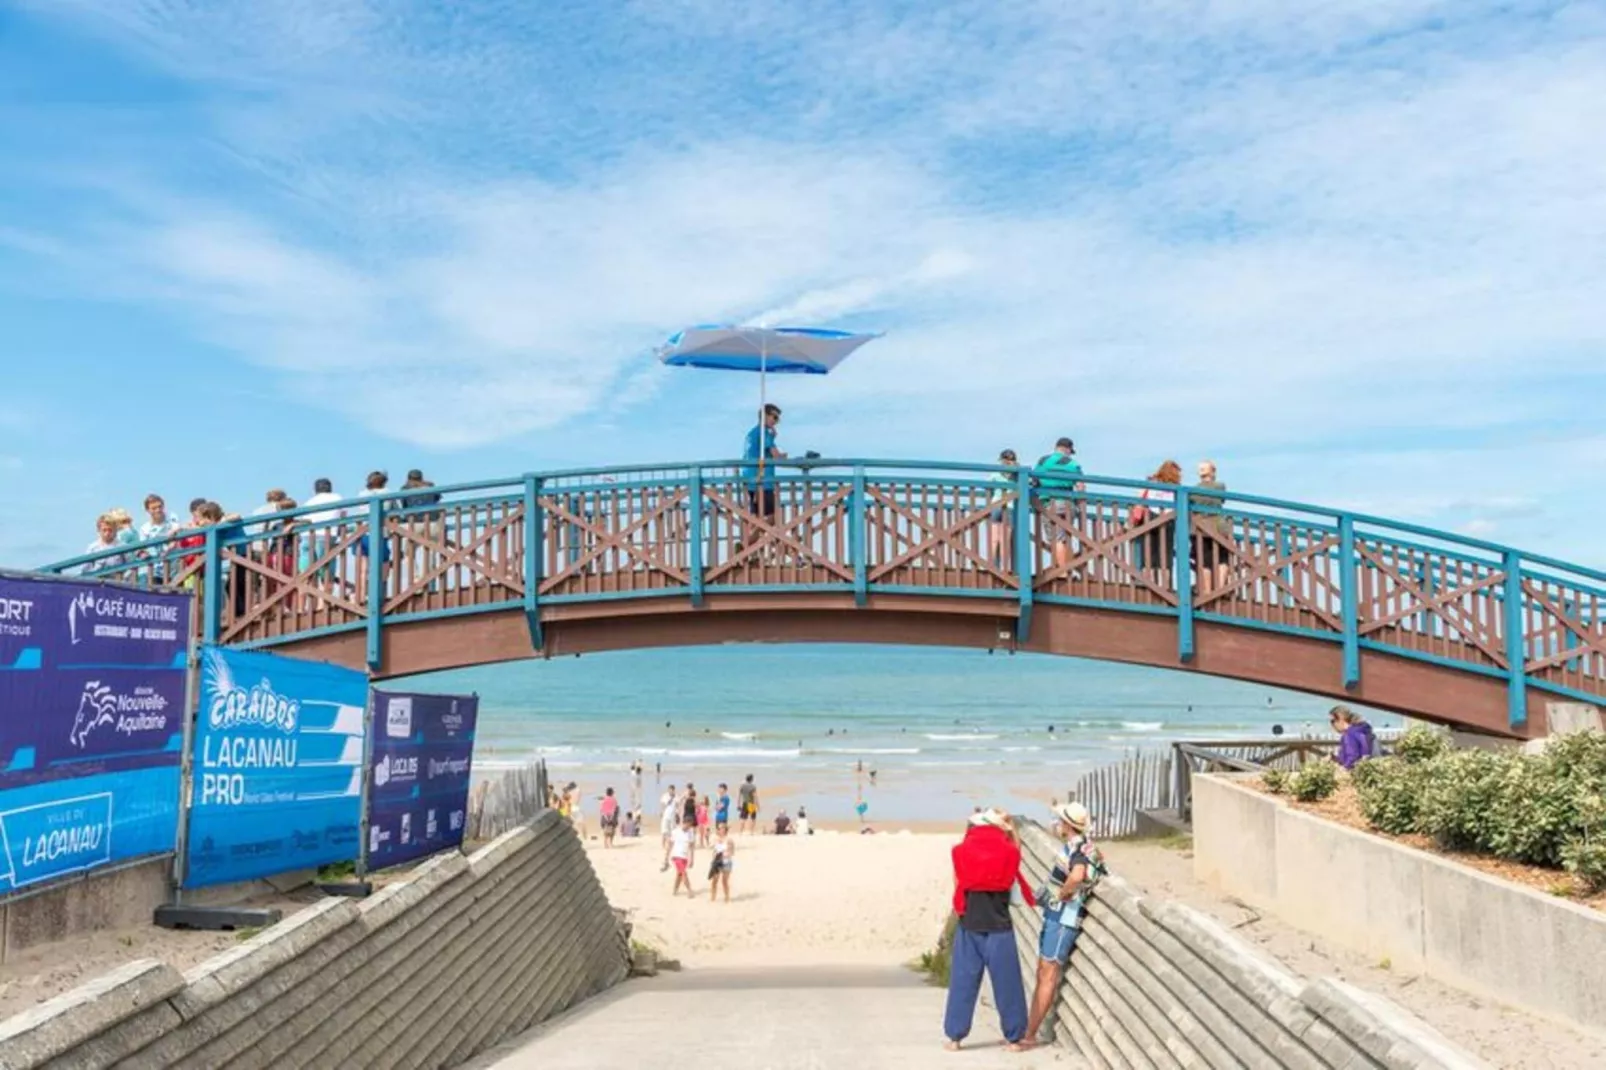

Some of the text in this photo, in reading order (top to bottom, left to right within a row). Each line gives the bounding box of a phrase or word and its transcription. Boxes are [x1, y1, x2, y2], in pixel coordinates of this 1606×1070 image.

[95, 597, 178, 622] CAFÉ MARITIME
[0, 623, 31, 637] TIQUE
[115, 713, 166, 736] Aquitaine
[203, 735, 297, 768] LACANAU
[202, 773, 244, 805] PRO
[23, 823, 102, 867] LACANAU
